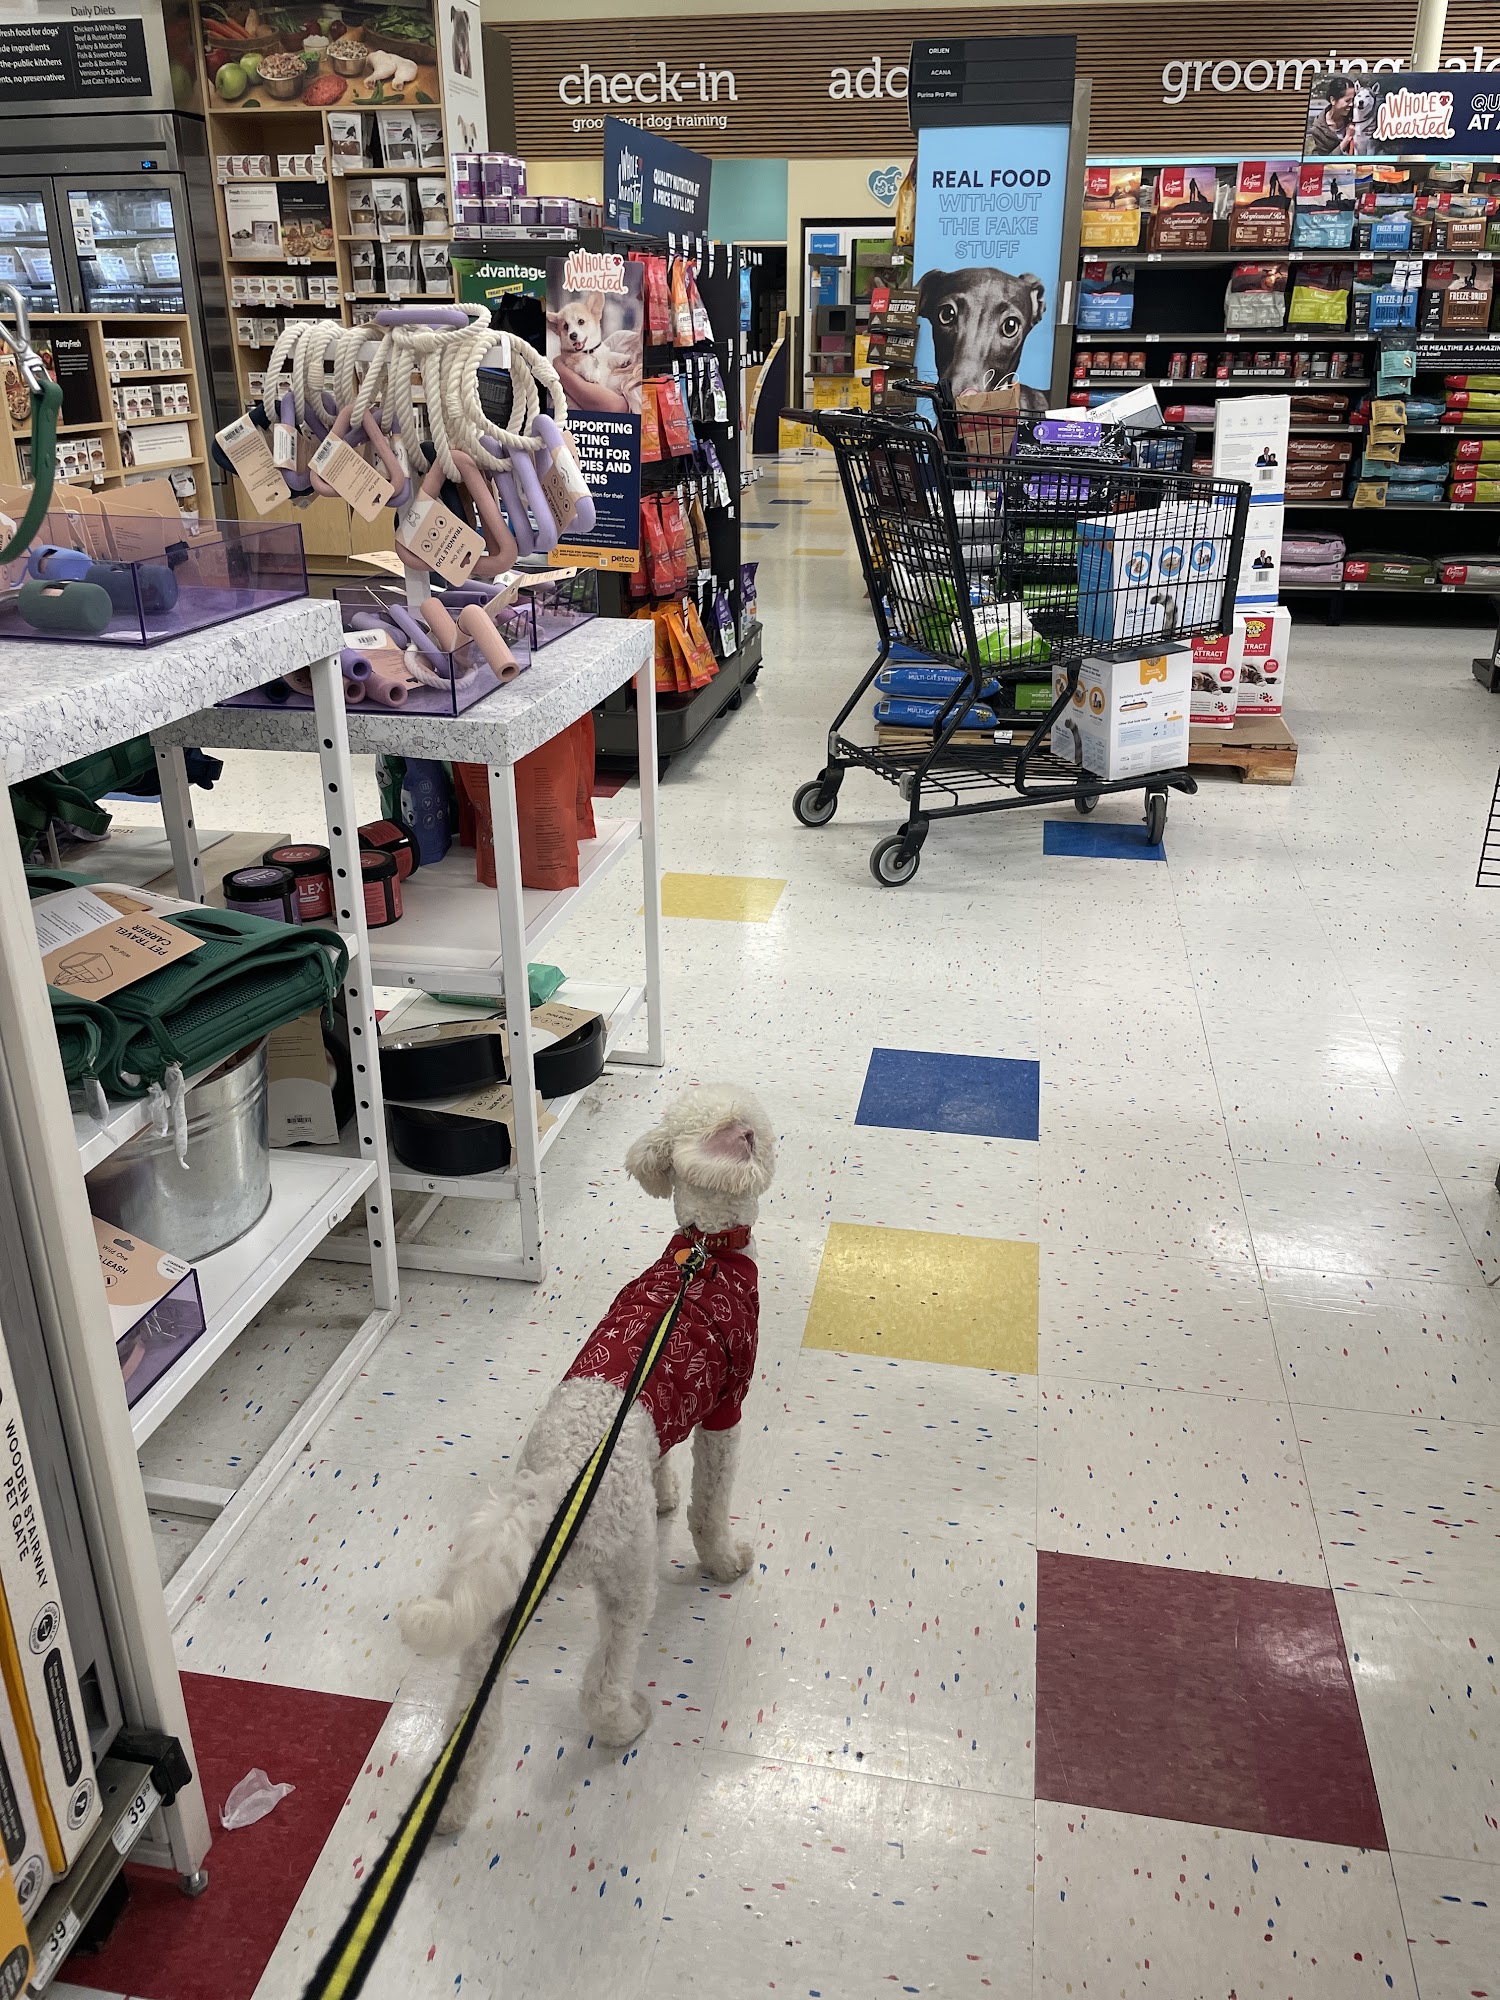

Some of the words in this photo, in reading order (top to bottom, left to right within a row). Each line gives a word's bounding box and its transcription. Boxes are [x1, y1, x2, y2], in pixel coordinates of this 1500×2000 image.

[71, 6, 92, 18] Daily
[94, 5, 116, 16] Diets
[16, 27, 31, 36] food
[32, 27, 41, 36] for
[73, 25, 95, 33] Chicken
[11, 44, 51, 54] ingredients
[76, 43, 94, 51] Turkey
[99, 42, 123, 50] Macaroni
[34, 58, 62, 67] kitchens
[79, 60, 94, 68] Lamb
[23, 73, 66, 84] preservatives
[80, 69, 101, 77] Venison
[106, 68, 125, 76] Squash
[121, 75, 142, 84] Chicken
[558, 62, 738, 105] check-in
[1388, 90, 1437, 119] WHOLE
[646, 114, 673, 131] dog
[676, 113, 728, 130] training
[1377, 106, 1451, 138] hearted
[1467, 113, 1494, 131] AT
[653, 168, 673, 189] QUALITY
[673, 175, 695, 196] NUTRITION
[932, 170, 984, 189] REAL
[990, 169, 1051, 188] FOOD
[657, 189, 671, 208] PRICE
[684, 197, 695, 214] LOVE
[939, 193, 1042, 212] WITHOUT
[1099, 212, 1123, 222] Puppy
[1238, 210, 1271, 221] Regional
[939, 217, 980, 236] THE
[985, 216, 1039, 236] FAKE
[1376, 224, 1407, 232] FREEZE-DRIED
[1452, 223, 1482, 231] FREEZE-DRIED
[954, 240, 1020, 259] STUFF
[572, 252, 612, 274] WHOLE
[565, 259, 624, 293] hearted
[1450, 291, 1488, 301] FREEZE-DRIED
[889, 303, 900, 312] BEEF
[900, 304, 916, 313] RECIPE
[55, 339, 82, 349] PantryFresh
[564, 420, 633, 435] UPPORTING
[573, 433, 610, 447] STING
[1288, 441, 1318, 451] Regional
[1318, 442, 1334, 451] Red
[606, 449, 630, 461] FOR
[605, 461, 632, 474] AND
[603, 492, 611, 500] for
[611, 492, 624, 500] their
[443, 526, 463, 557] TRIANGLE
[457, 543, 466, 555] Wild
[435, 555, 446, 568] TUG
[450, 554, 459, 565] One
[611, 555, 635, 563] petco
[1382, 566, 1409, 575] Tundra
[1193, 650, 1225, 658] ATTRACT
[282, 850, 314, 858] FLEX
[241, 871, 277, 884] CALM
[299, 881, 325, 896] LEX
[115, 926, 150, 947] TRAVEL
[131, 924, 172, 947] CARRIER
[109, 944, 120, 952] One
[119, 950, 131, 958] Wild
[148, 944, 169, 956] PET
[102, 1244, 116, 1255] Wild
[116, 1252, 128, 1262] One
[102, 1257, 129, 1275] LEASH
[5, 1418, 29, 1501] WOODEN
[22, 1504, 48, 1589] STAIRWAY
[3, 1478, 19, 1512] PET
[11, 1512, 30, 1562] GATE
